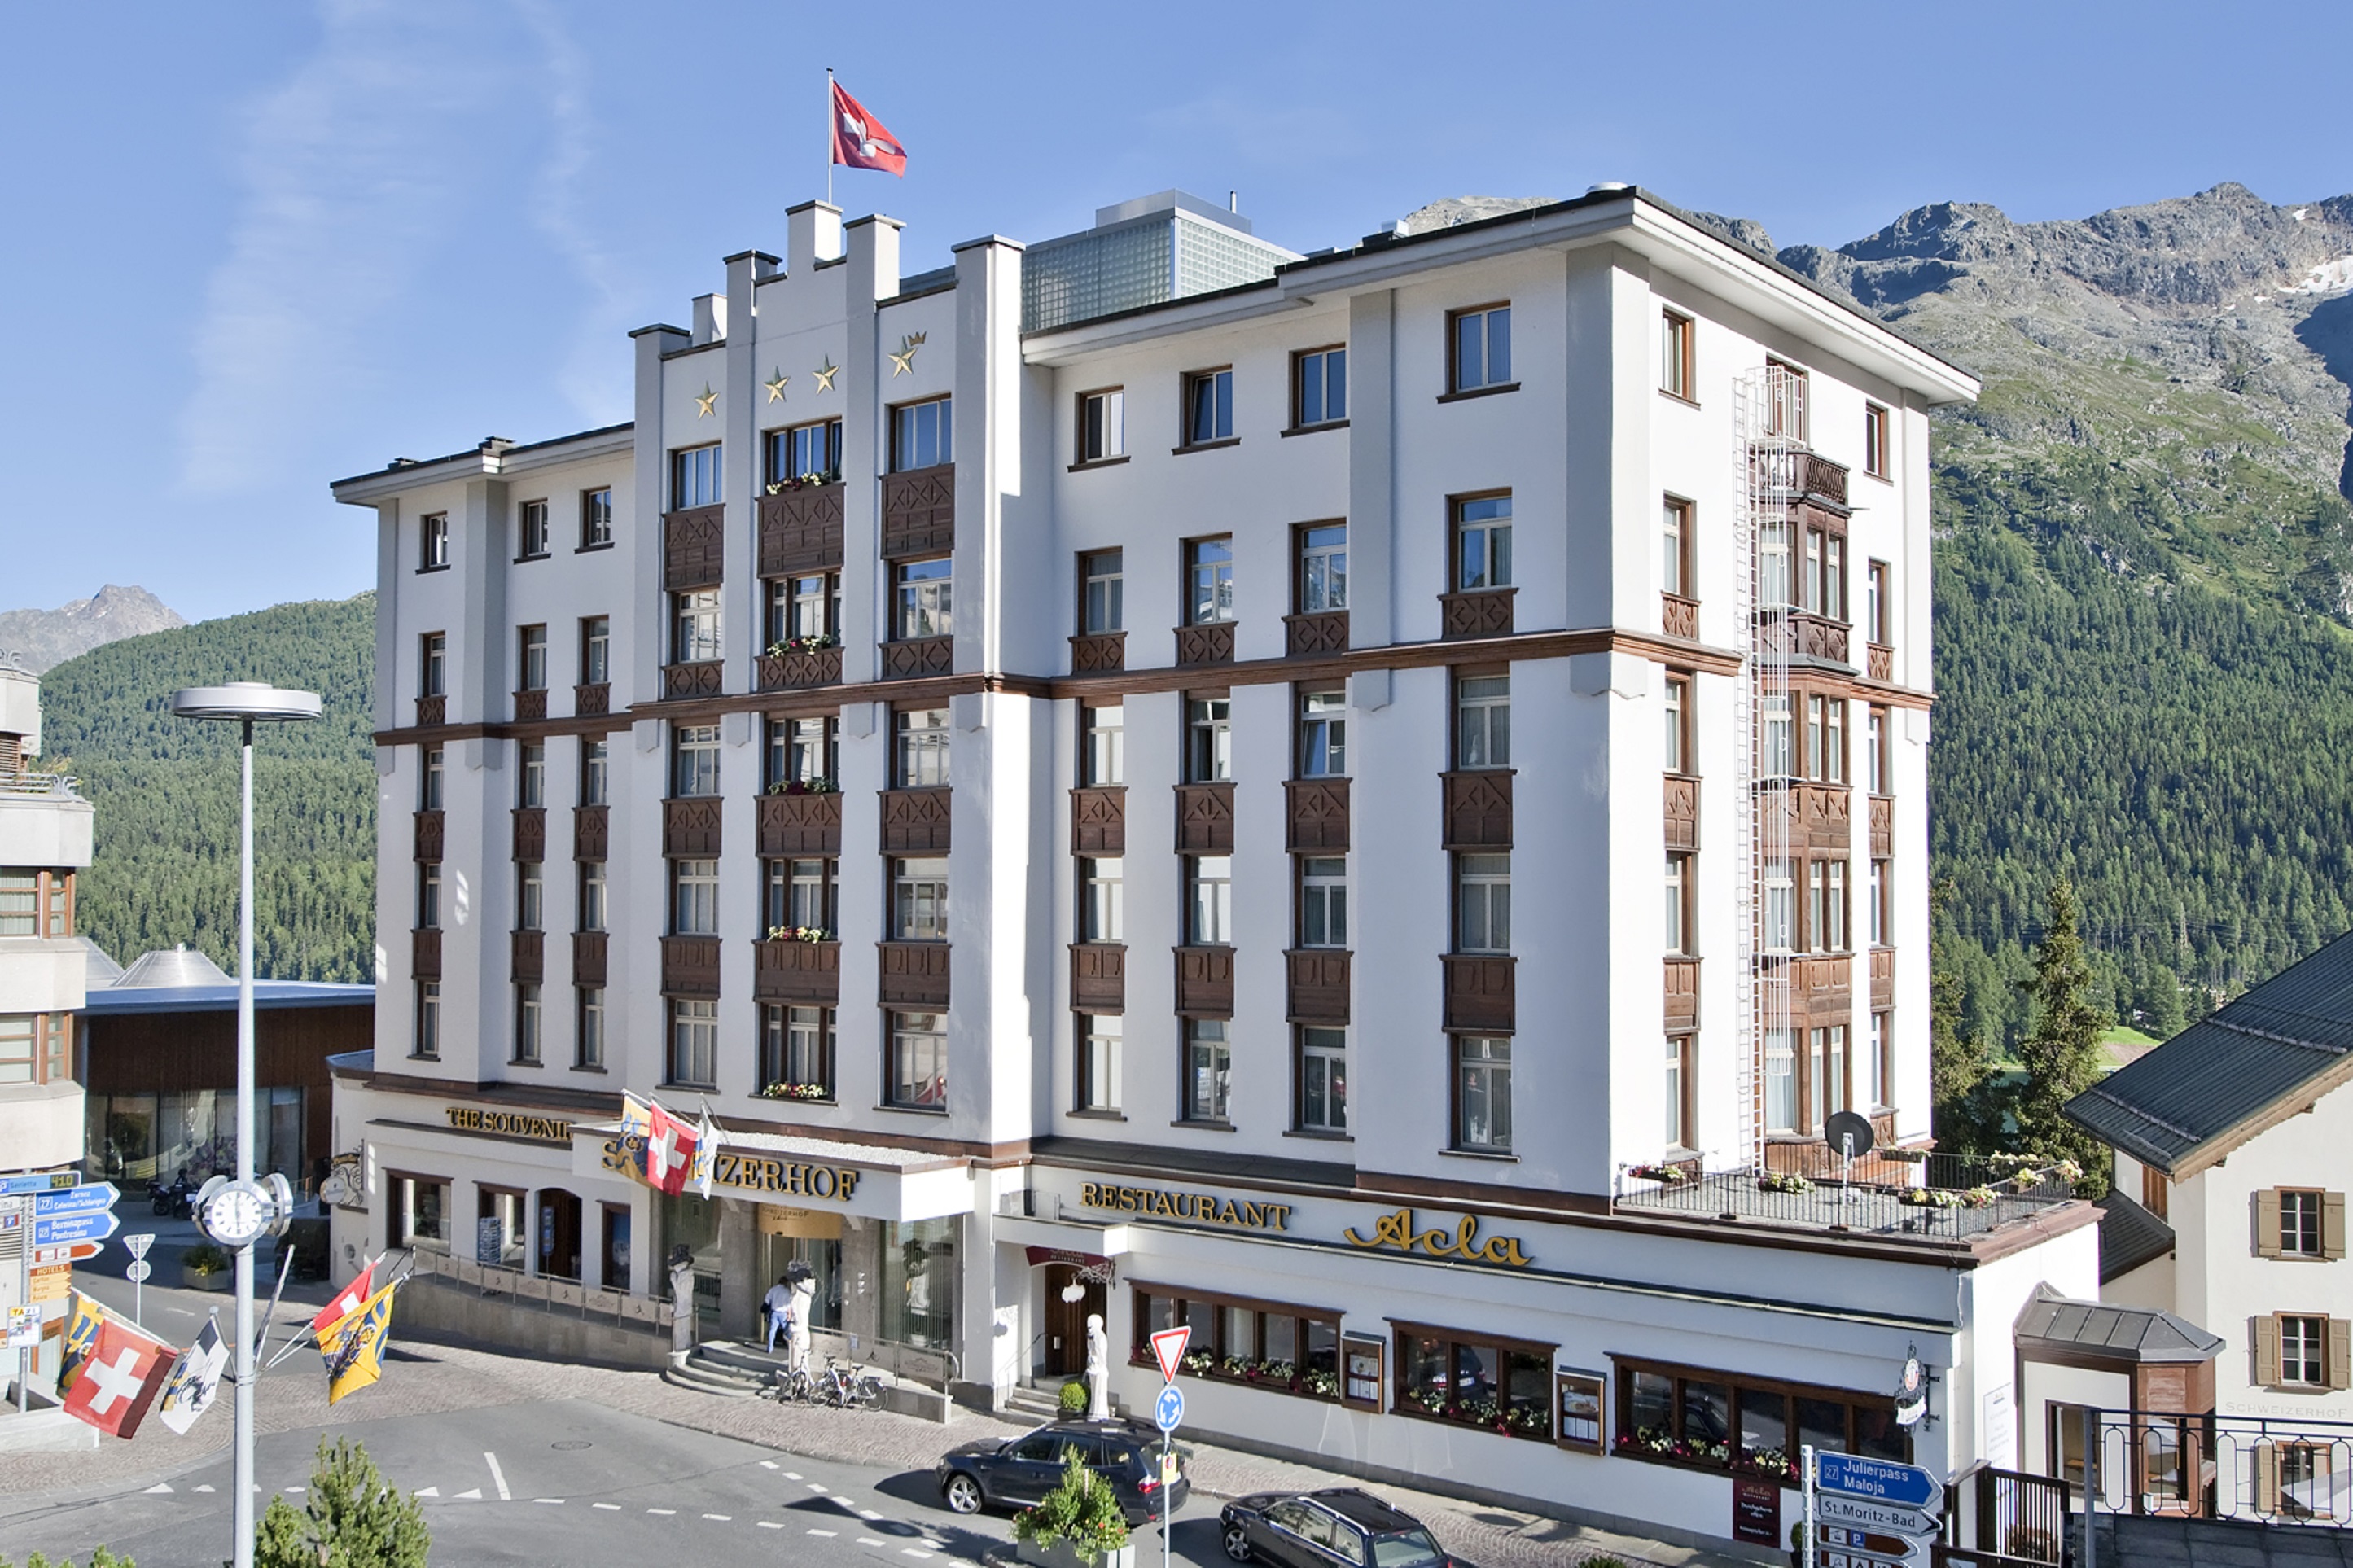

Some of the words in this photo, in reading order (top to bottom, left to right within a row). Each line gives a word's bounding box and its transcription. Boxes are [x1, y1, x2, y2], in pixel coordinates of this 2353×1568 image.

[445, 1108, 480, 1129] THE
[601, 1139, 860, 1202] SZERHOF
[51, 1218, 94, 1231] Berninapass
[1080, 1182, 1292, 1231] RESTAURANT
[1342, 1208, 1534, 1267] Acla
[37, 1264, 65, 1275] HOTELS
[2224, 1401, 2348, 1418] SCHWEIZERHOF
[1825, 1466, 1838, 1479] 27
[1843, 1460, 1909, 1483] Julierpass
[1843, 1474, 1886, 1495] Maloja
